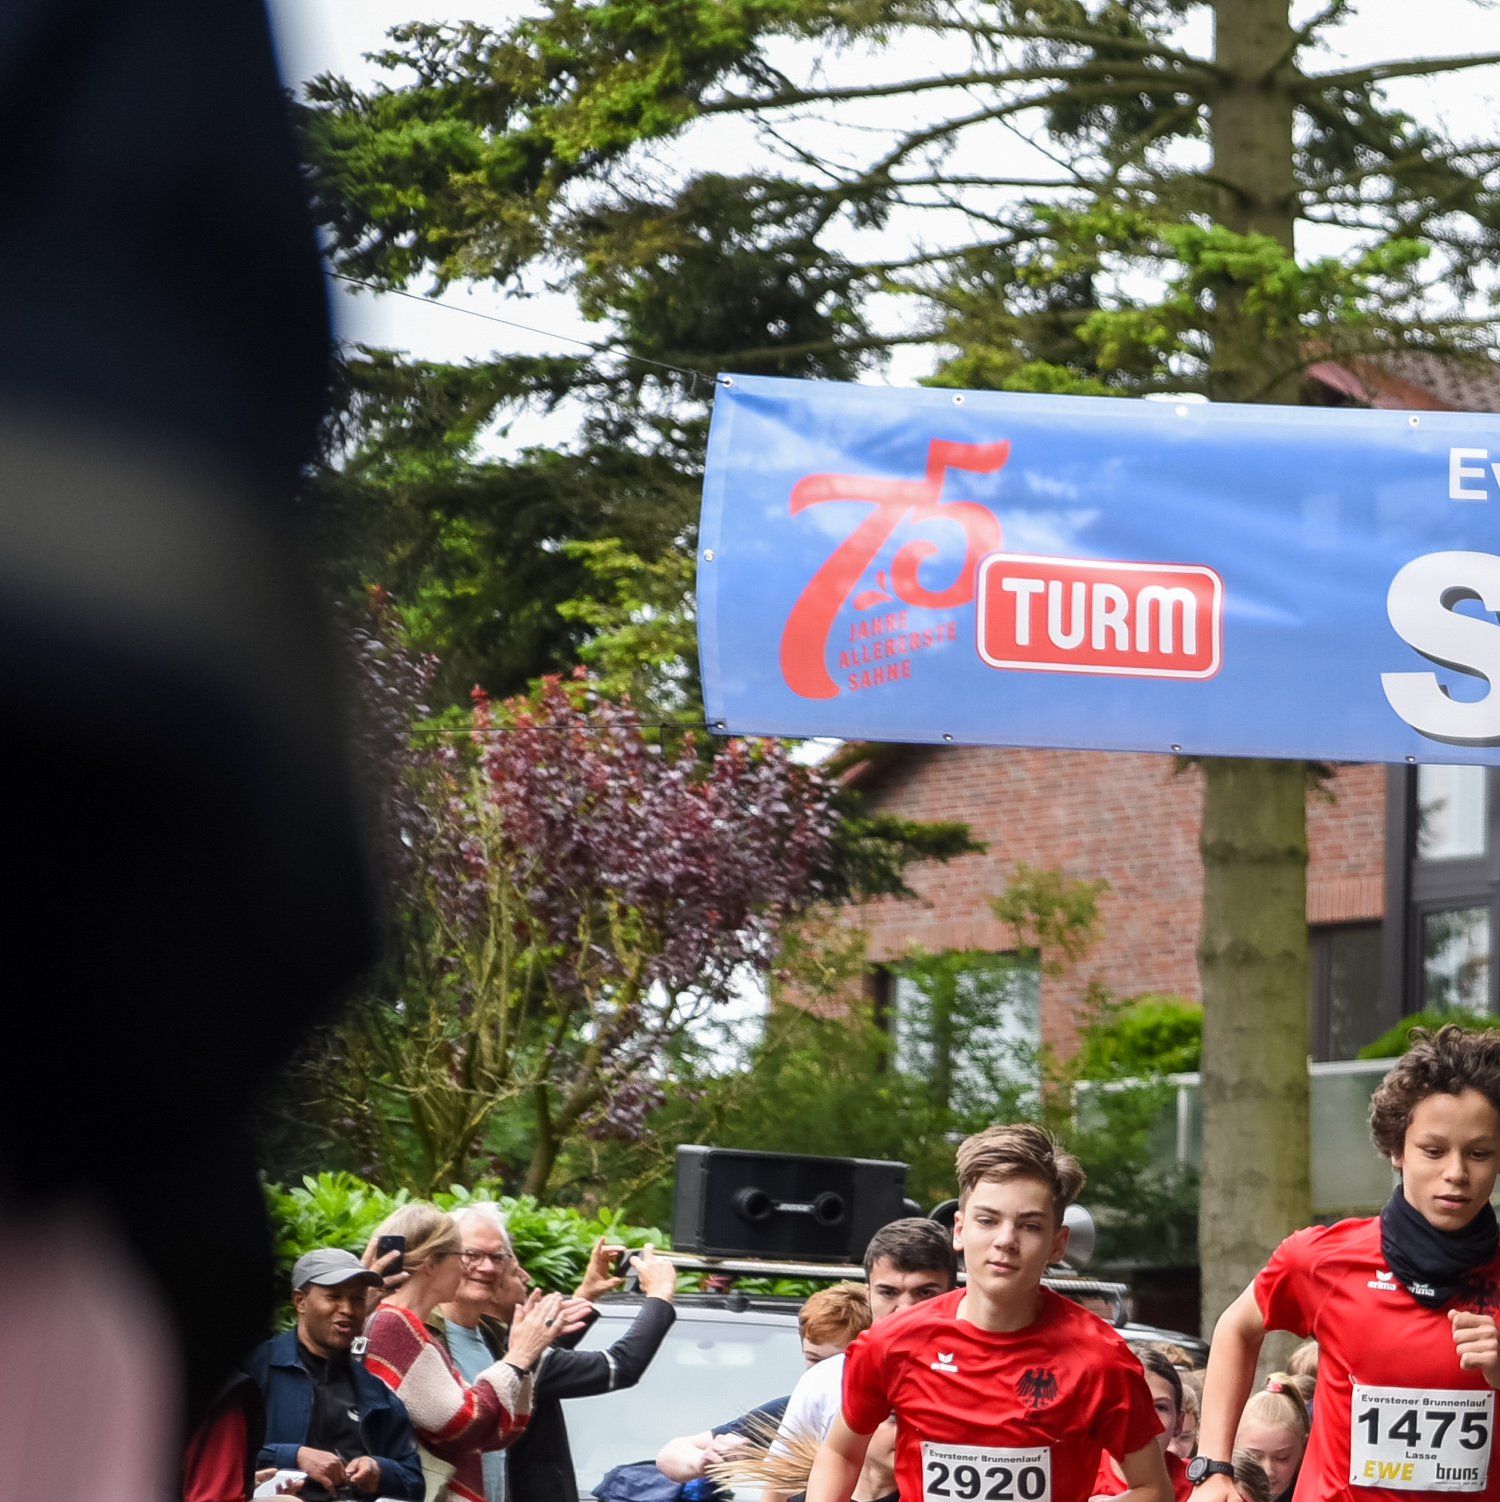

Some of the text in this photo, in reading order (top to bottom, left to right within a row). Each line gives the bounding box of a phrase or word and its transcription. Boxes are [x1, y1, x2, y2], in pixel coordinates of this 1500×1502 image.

[779, 438, 1011, 700] 75
[849, 609, 907, 643] JAHRE
[1002, 578, 1197, 656] TURM
[839, 620, 957, 669] ALLERERSTE
[848, 659, 910, 691] SAHNE
[1361, 1394, 1486, 1407] Everstener Brunnenlauf
[1358, 1407, 1488, 1450] 1475
[929, 1449, 1041, 1463] Everstener Brunnenlauf
[1363, 1460, 1479, 1481] EWE bruns
[1405, 1451, 1437, 1460] Lasse
[927, 1461, 1046, 1500] 2920
